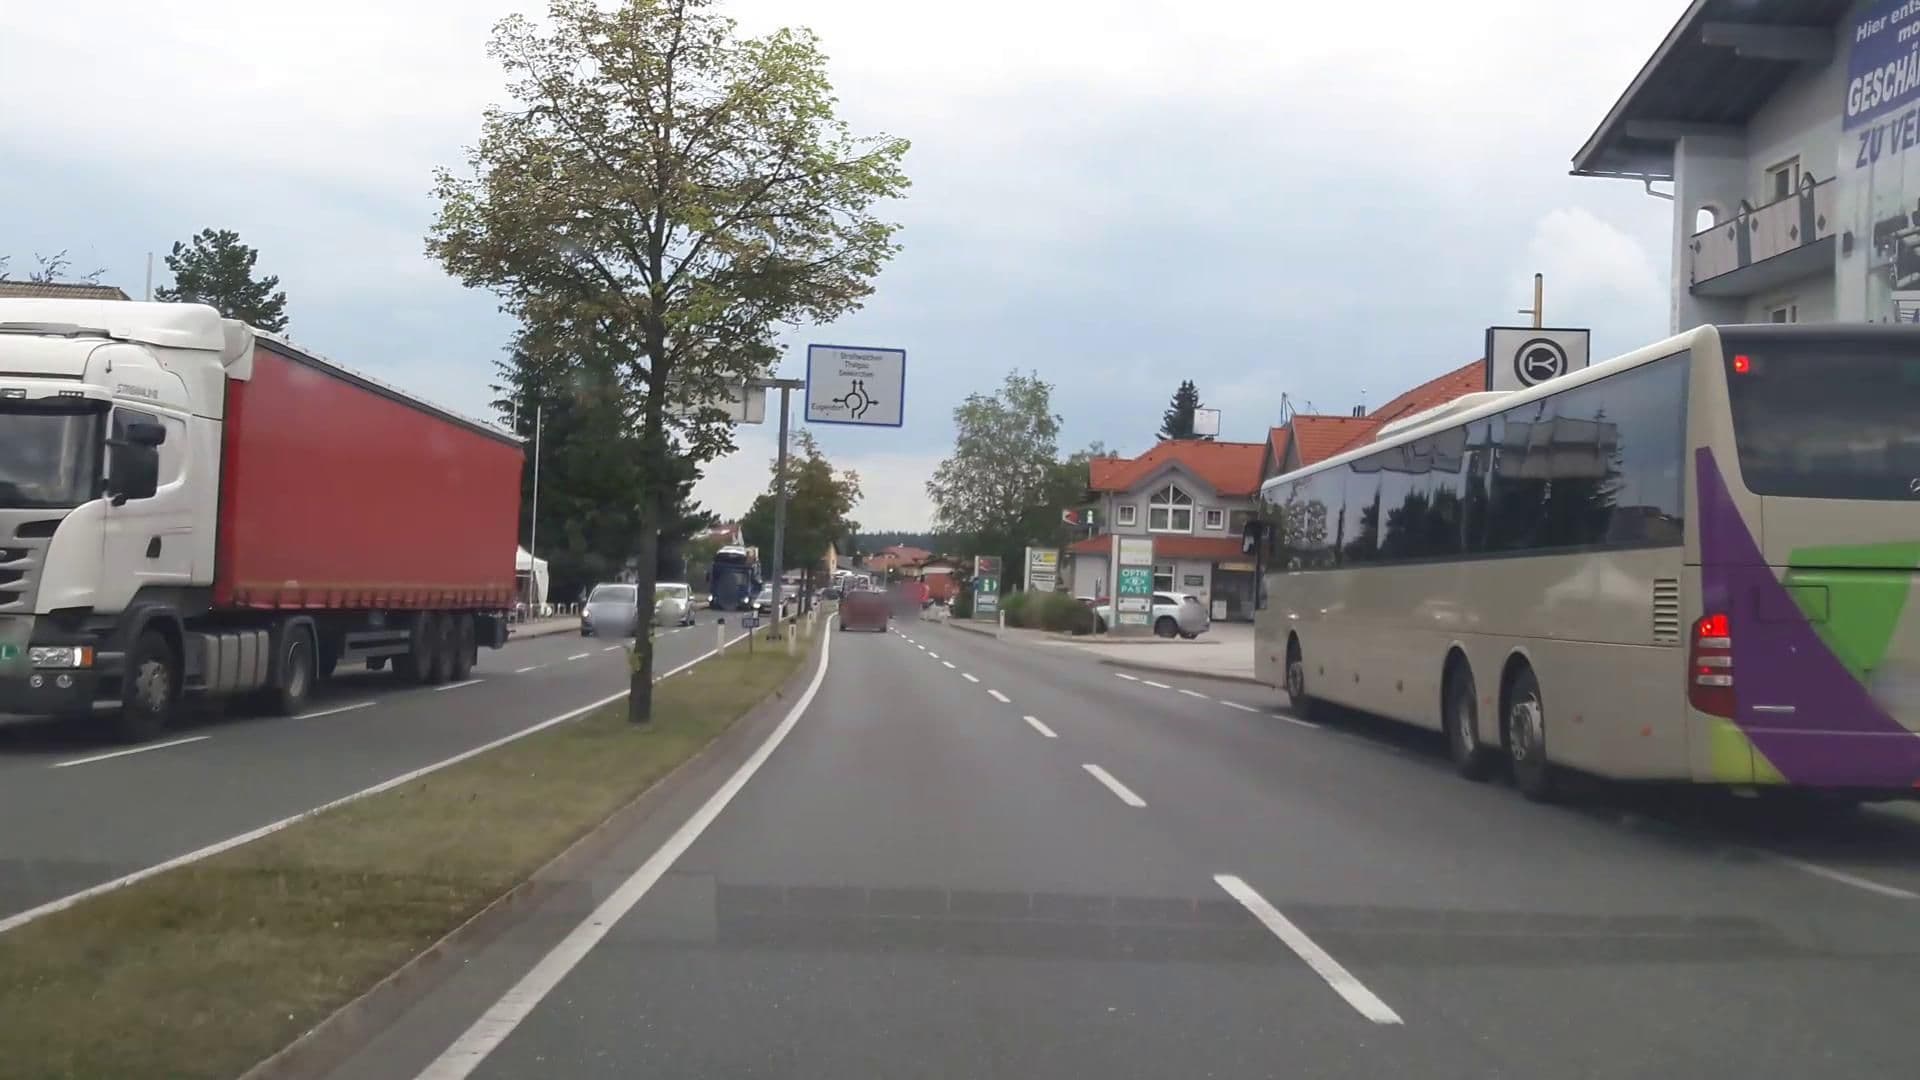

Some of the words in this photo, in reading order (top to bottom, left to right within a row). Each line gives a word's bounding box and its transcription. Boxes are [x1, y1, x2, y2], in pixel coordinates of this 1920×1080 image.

[1856, 16, 1887, 42] Hier
[1848, 40, 1920, 117] GESCHÄ
[1856, 123, 1885, 169] ZU
[1891, 105, 1920, 156] VE
